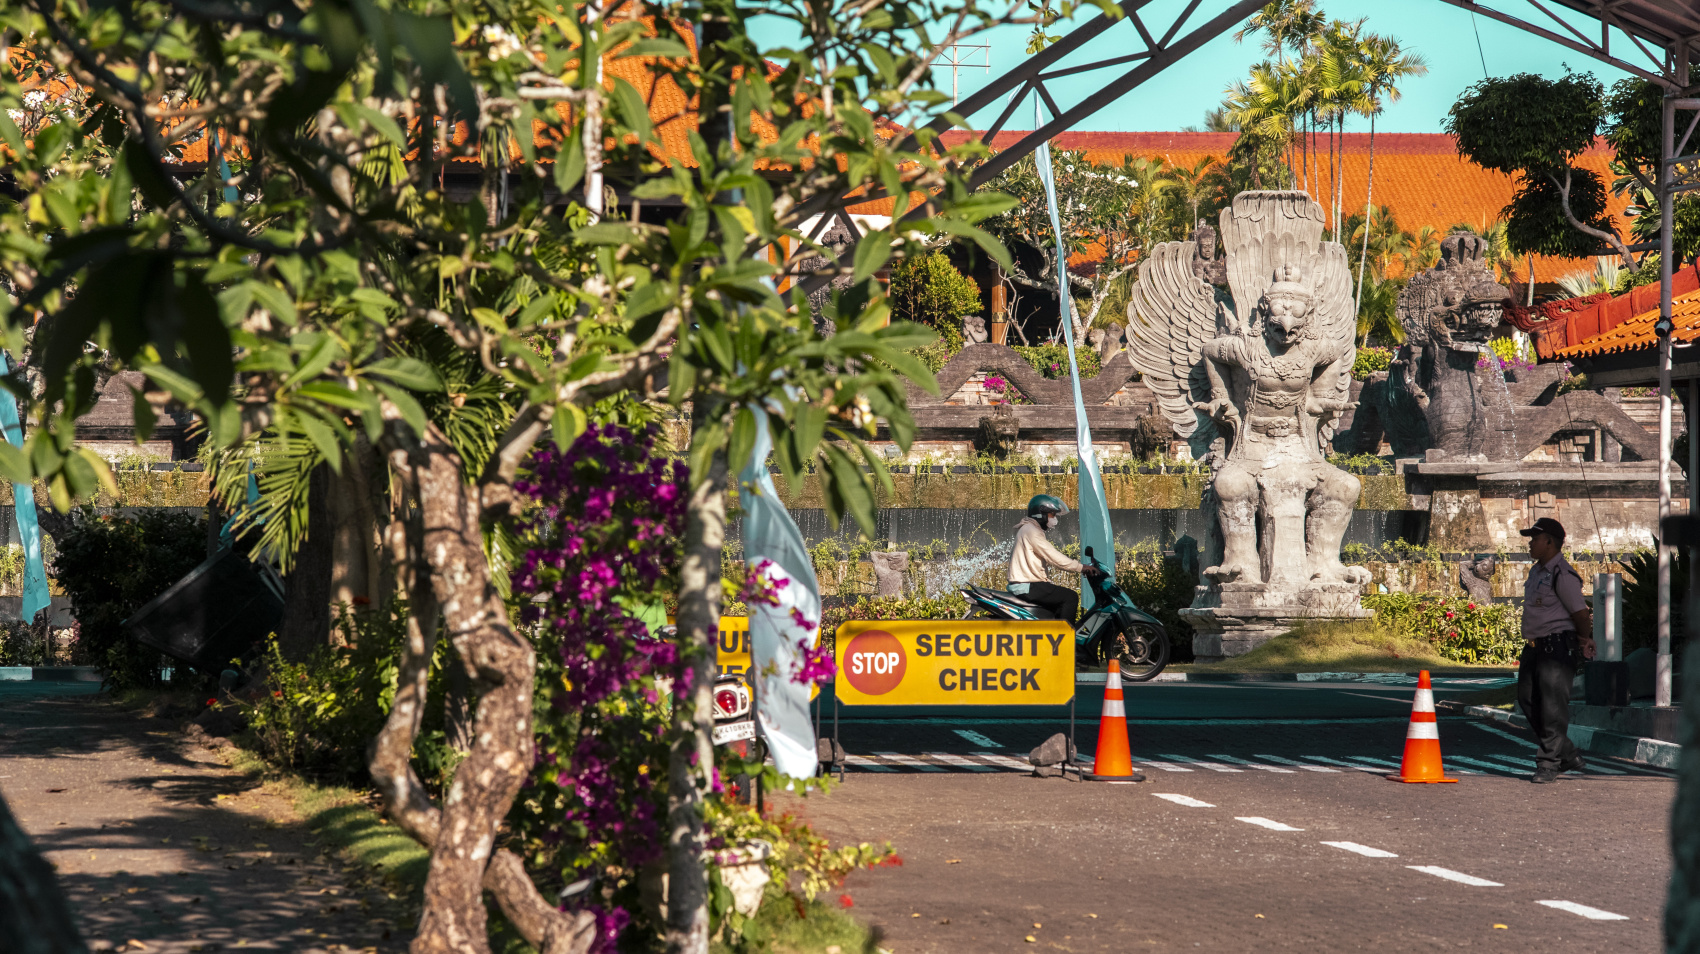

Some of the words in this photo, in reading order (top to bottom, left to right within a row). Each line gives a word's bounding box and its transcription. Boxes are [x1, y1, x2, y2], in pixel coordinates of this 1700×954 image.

[915, 633, 1066, 657] SECURITY
[851, 652, 900, 674] STOP
[938, 668, 1041, 691] CHECK
